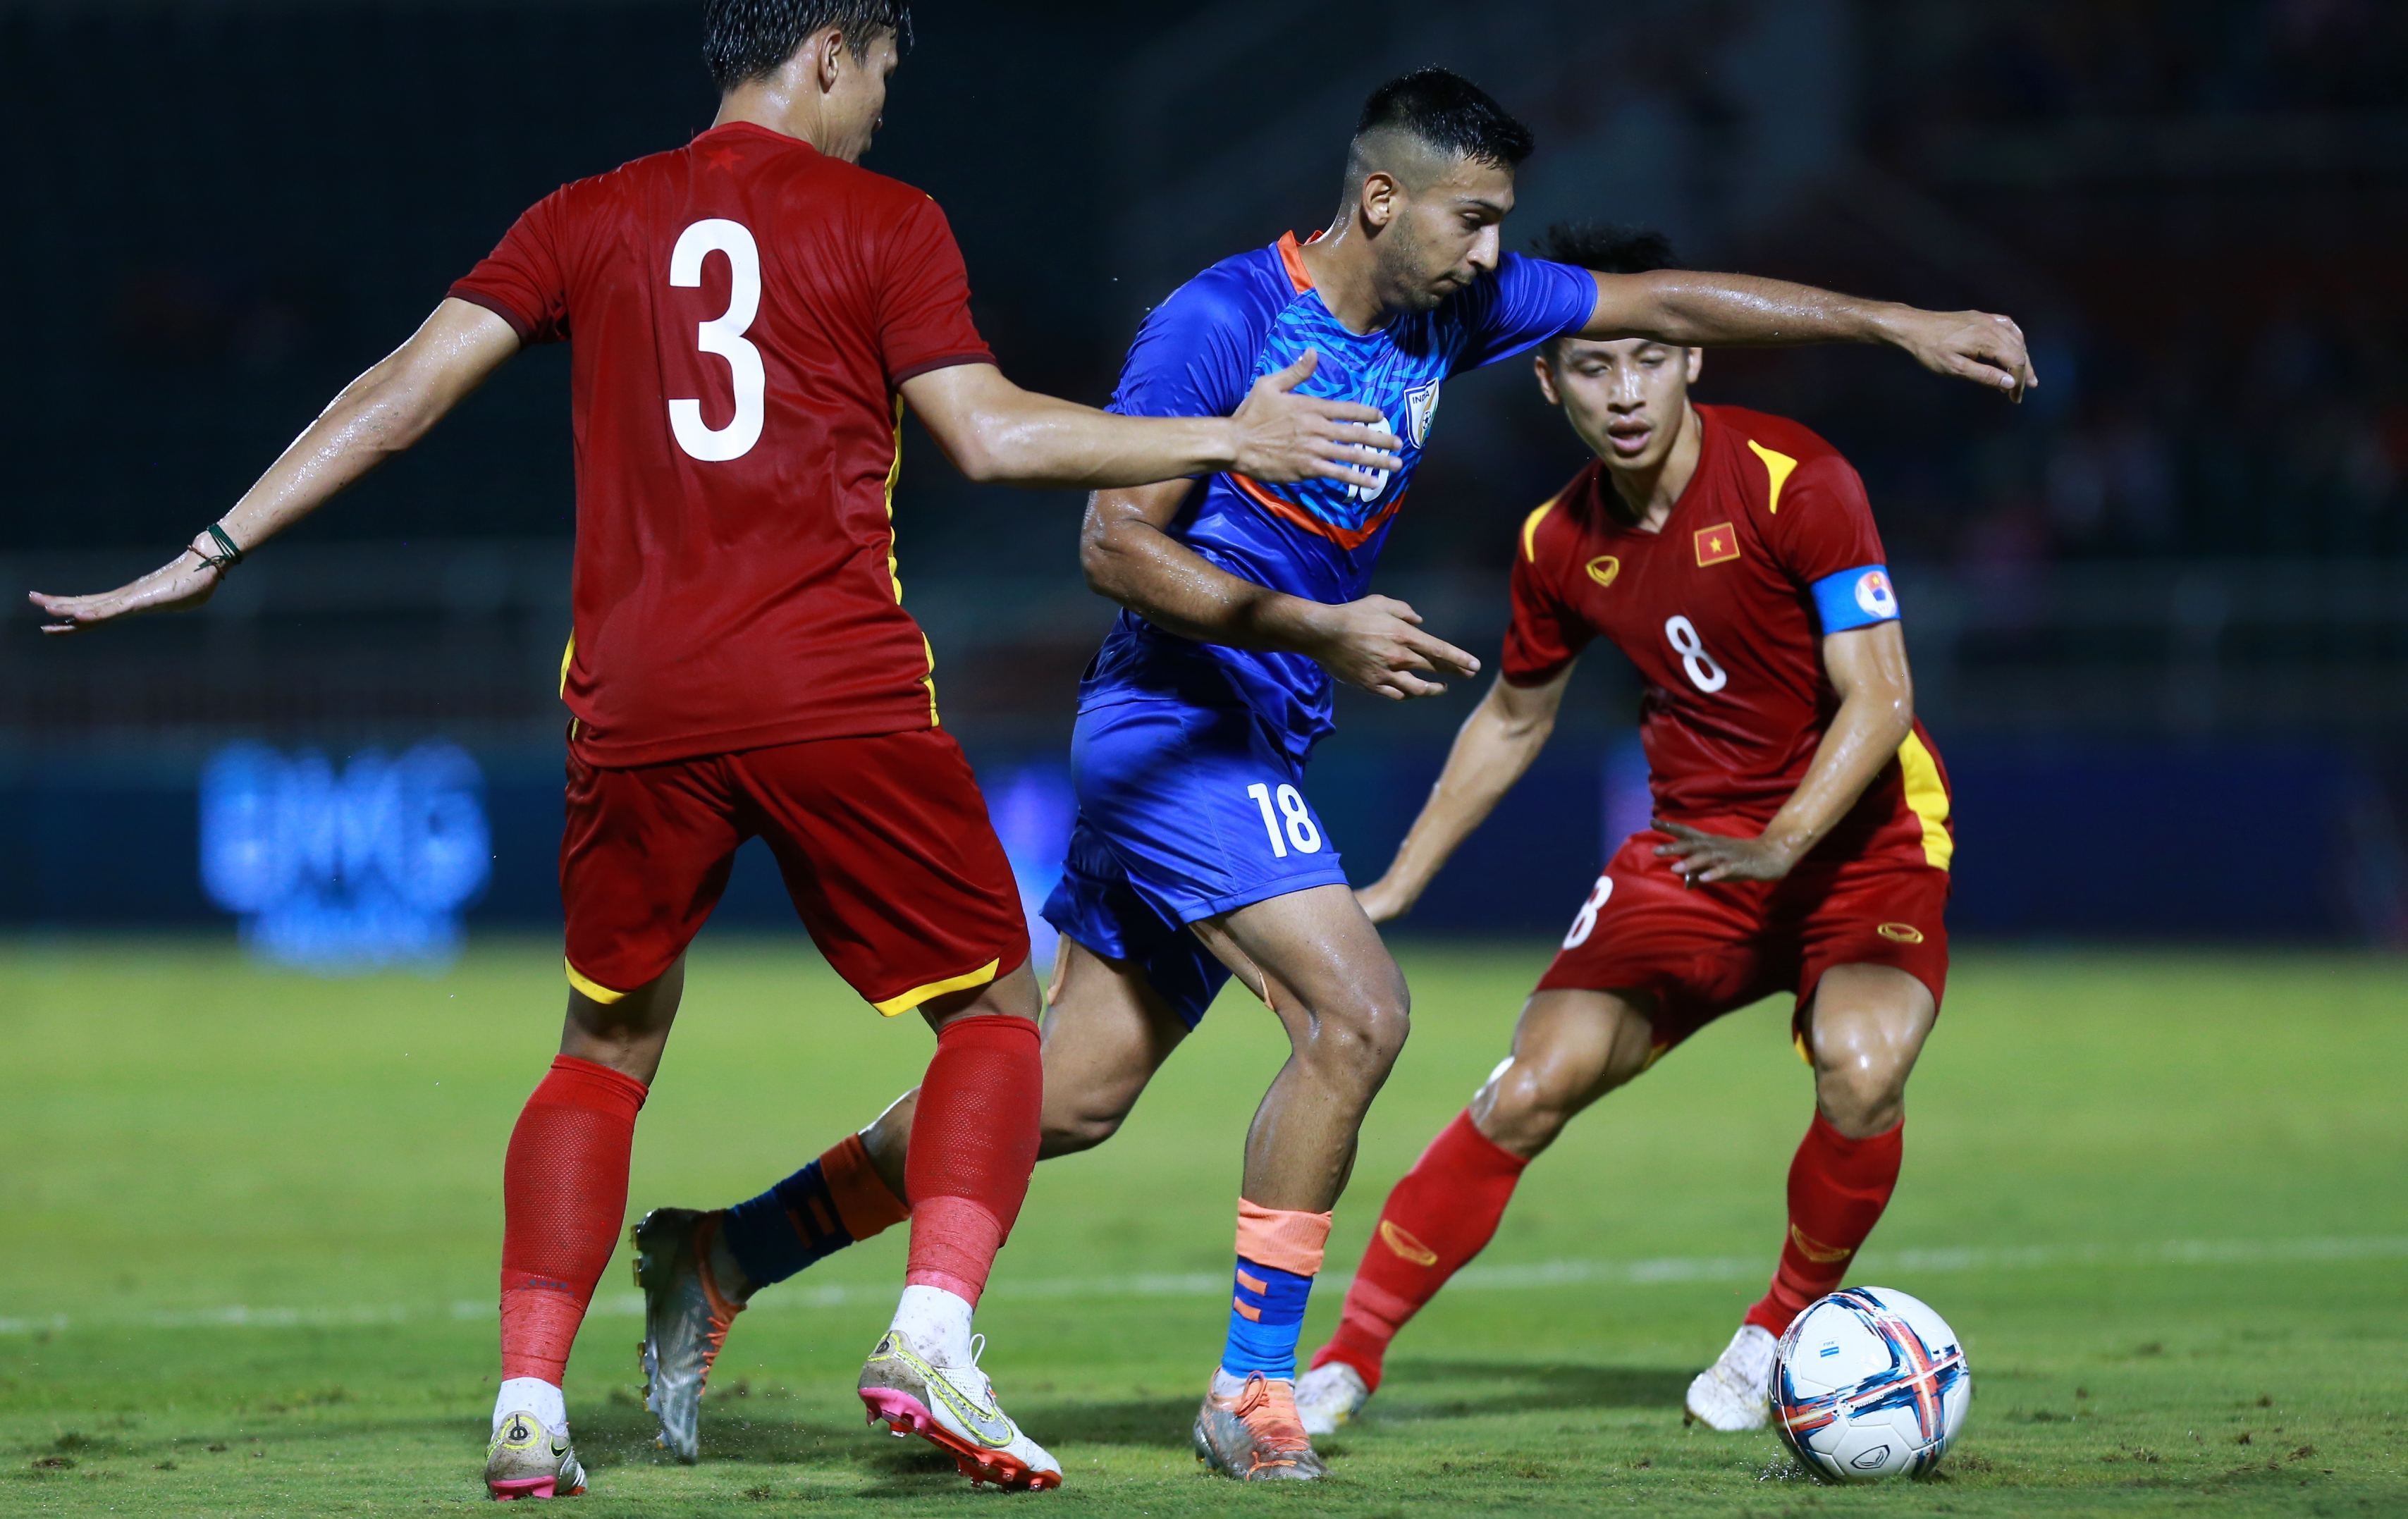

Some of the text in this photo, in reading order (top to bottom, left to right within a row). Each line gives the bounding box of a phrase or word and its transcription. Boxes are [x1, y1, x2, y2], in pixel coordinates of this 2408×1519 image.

[668, 218, 766, 462] 3
[1412, 390, 1430, 404] INDA
[1665, 615, 1727, 693] 8
[1247, 782, 1322, 858] 18
[1562, 875, 1614, 950] 8
